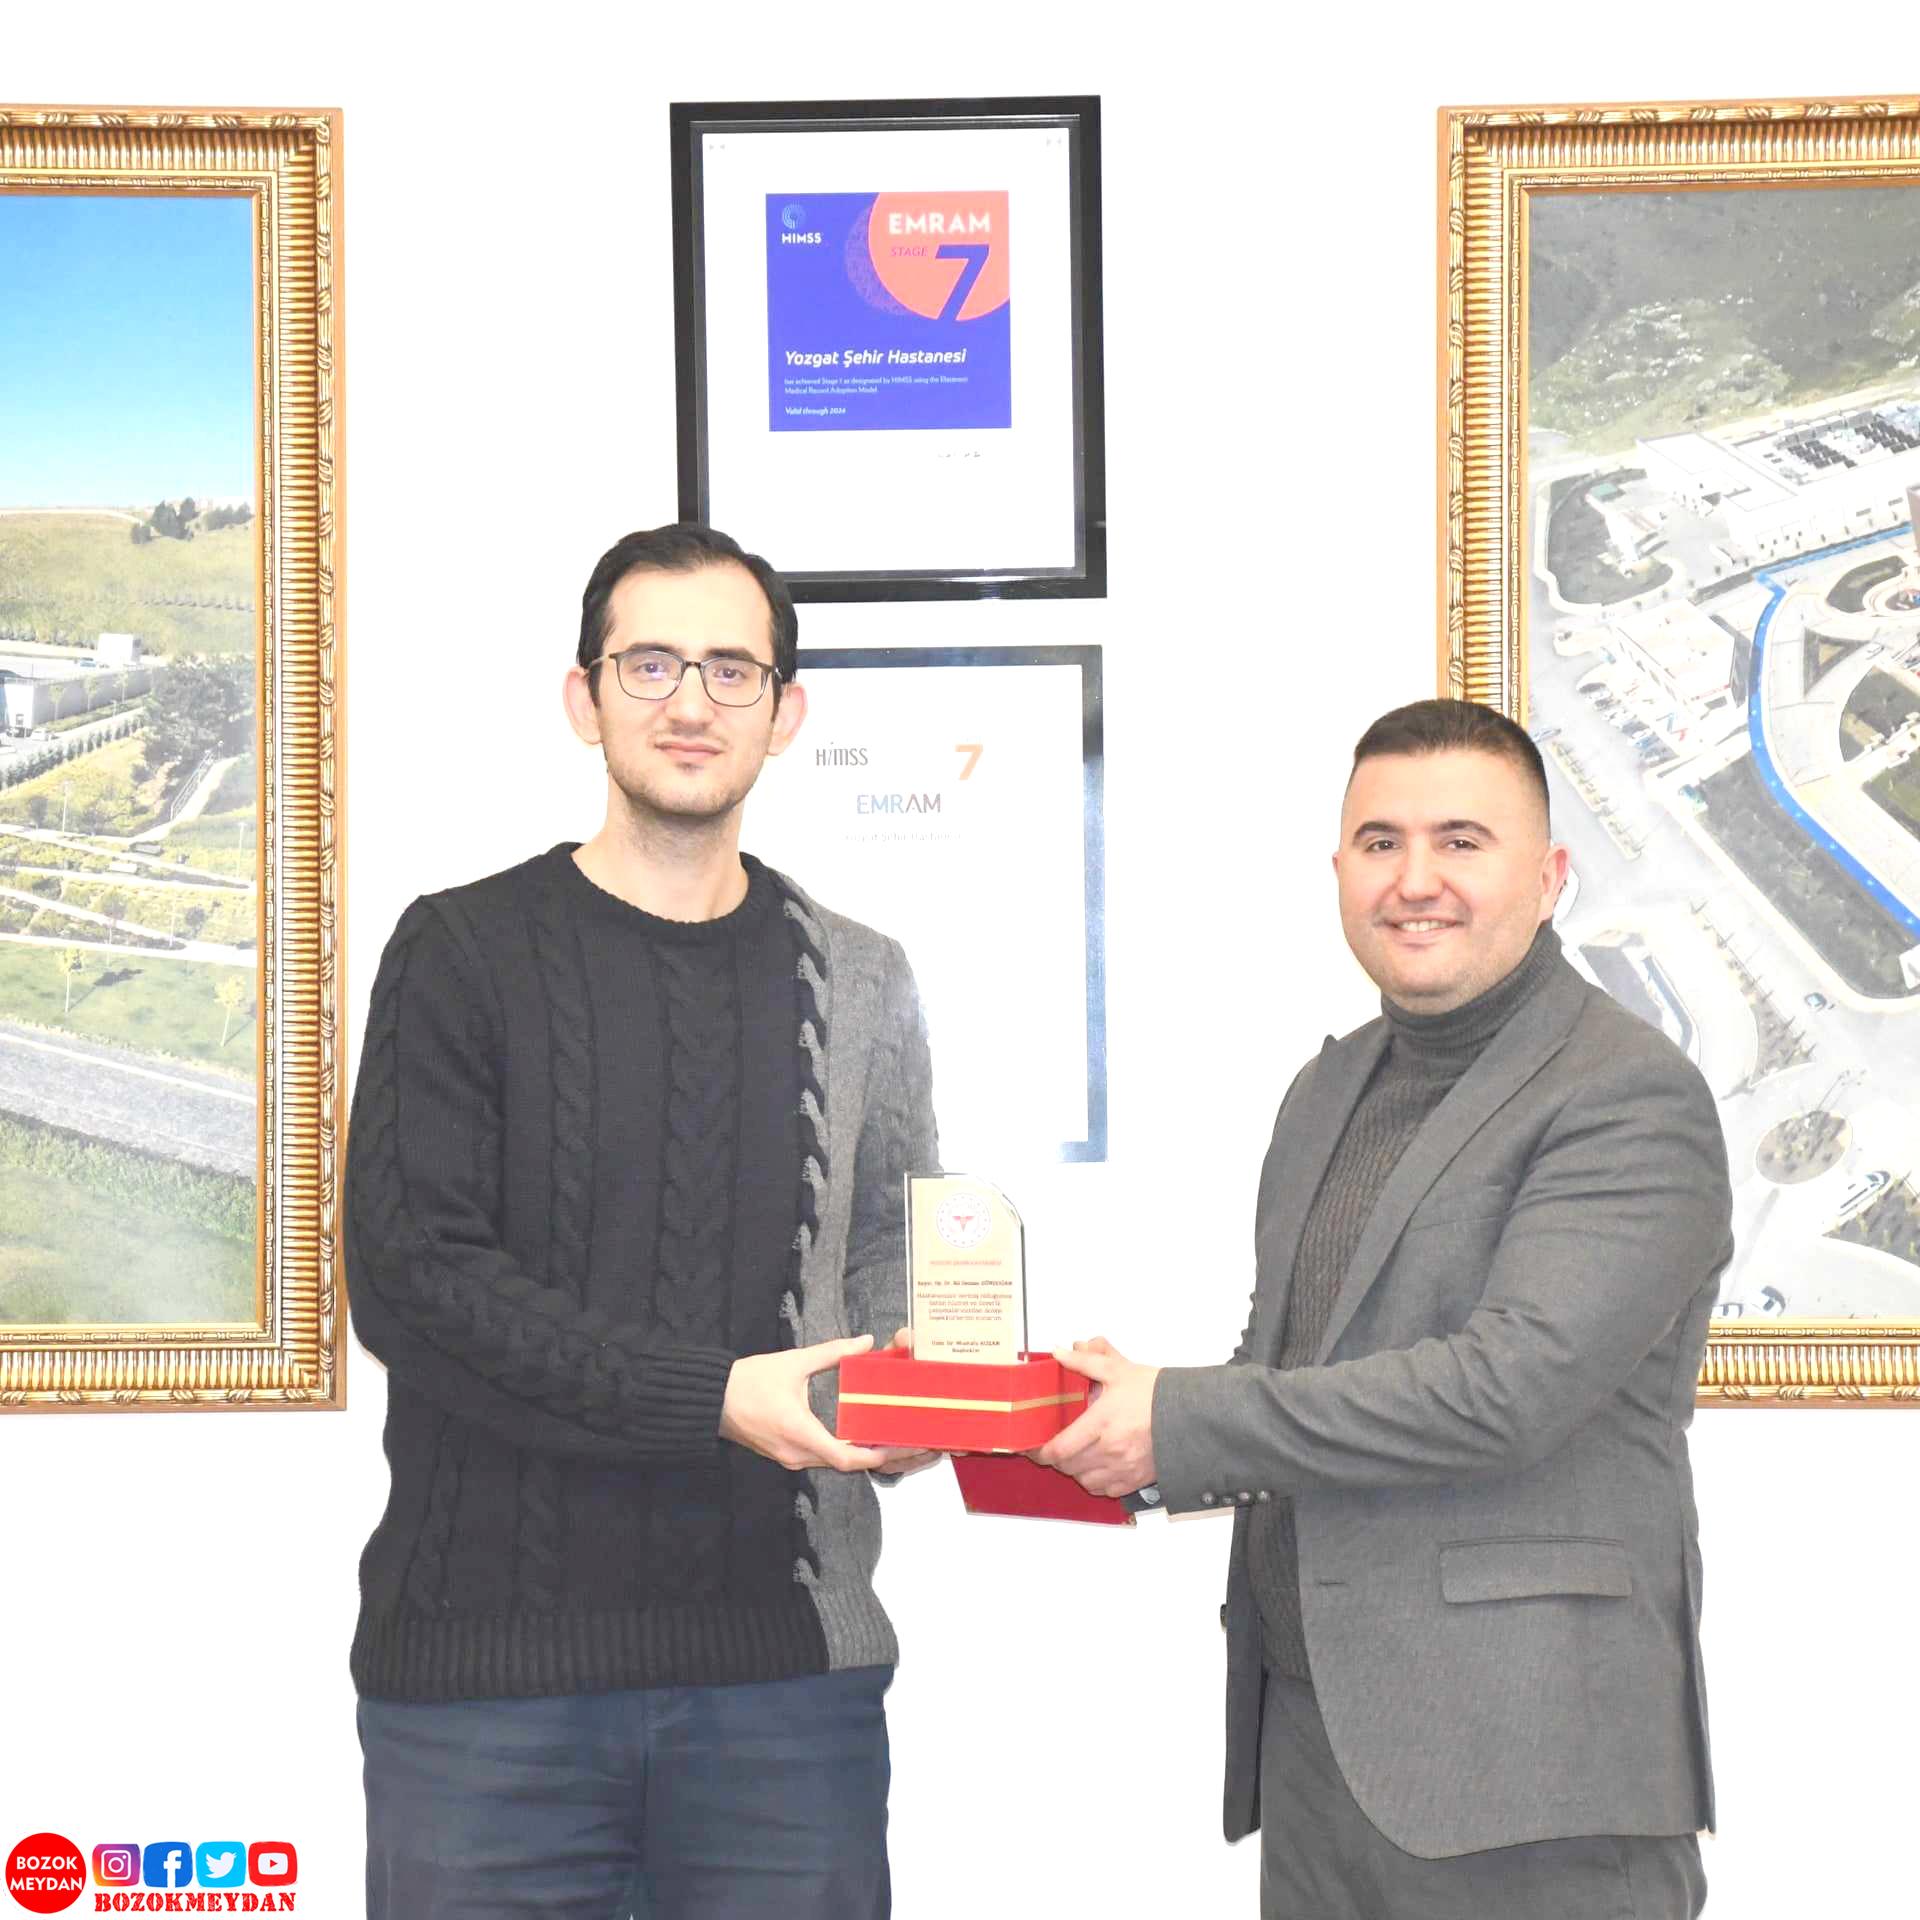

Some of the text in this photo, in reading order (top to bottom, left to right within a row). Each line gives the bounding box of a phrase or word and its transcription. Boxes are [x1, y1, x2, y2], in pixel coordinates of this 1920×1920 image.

[887, 211, 992, 236] EMRAM
[781, 232, 822, 245] HIMSS
[934, 244, 991, 322] 7
[785, 348, 967, 369] Yozgat Şehir Hastanesi
[954, 742, 984, 782] 7
[856, 793, 942, 815] EMRAM
